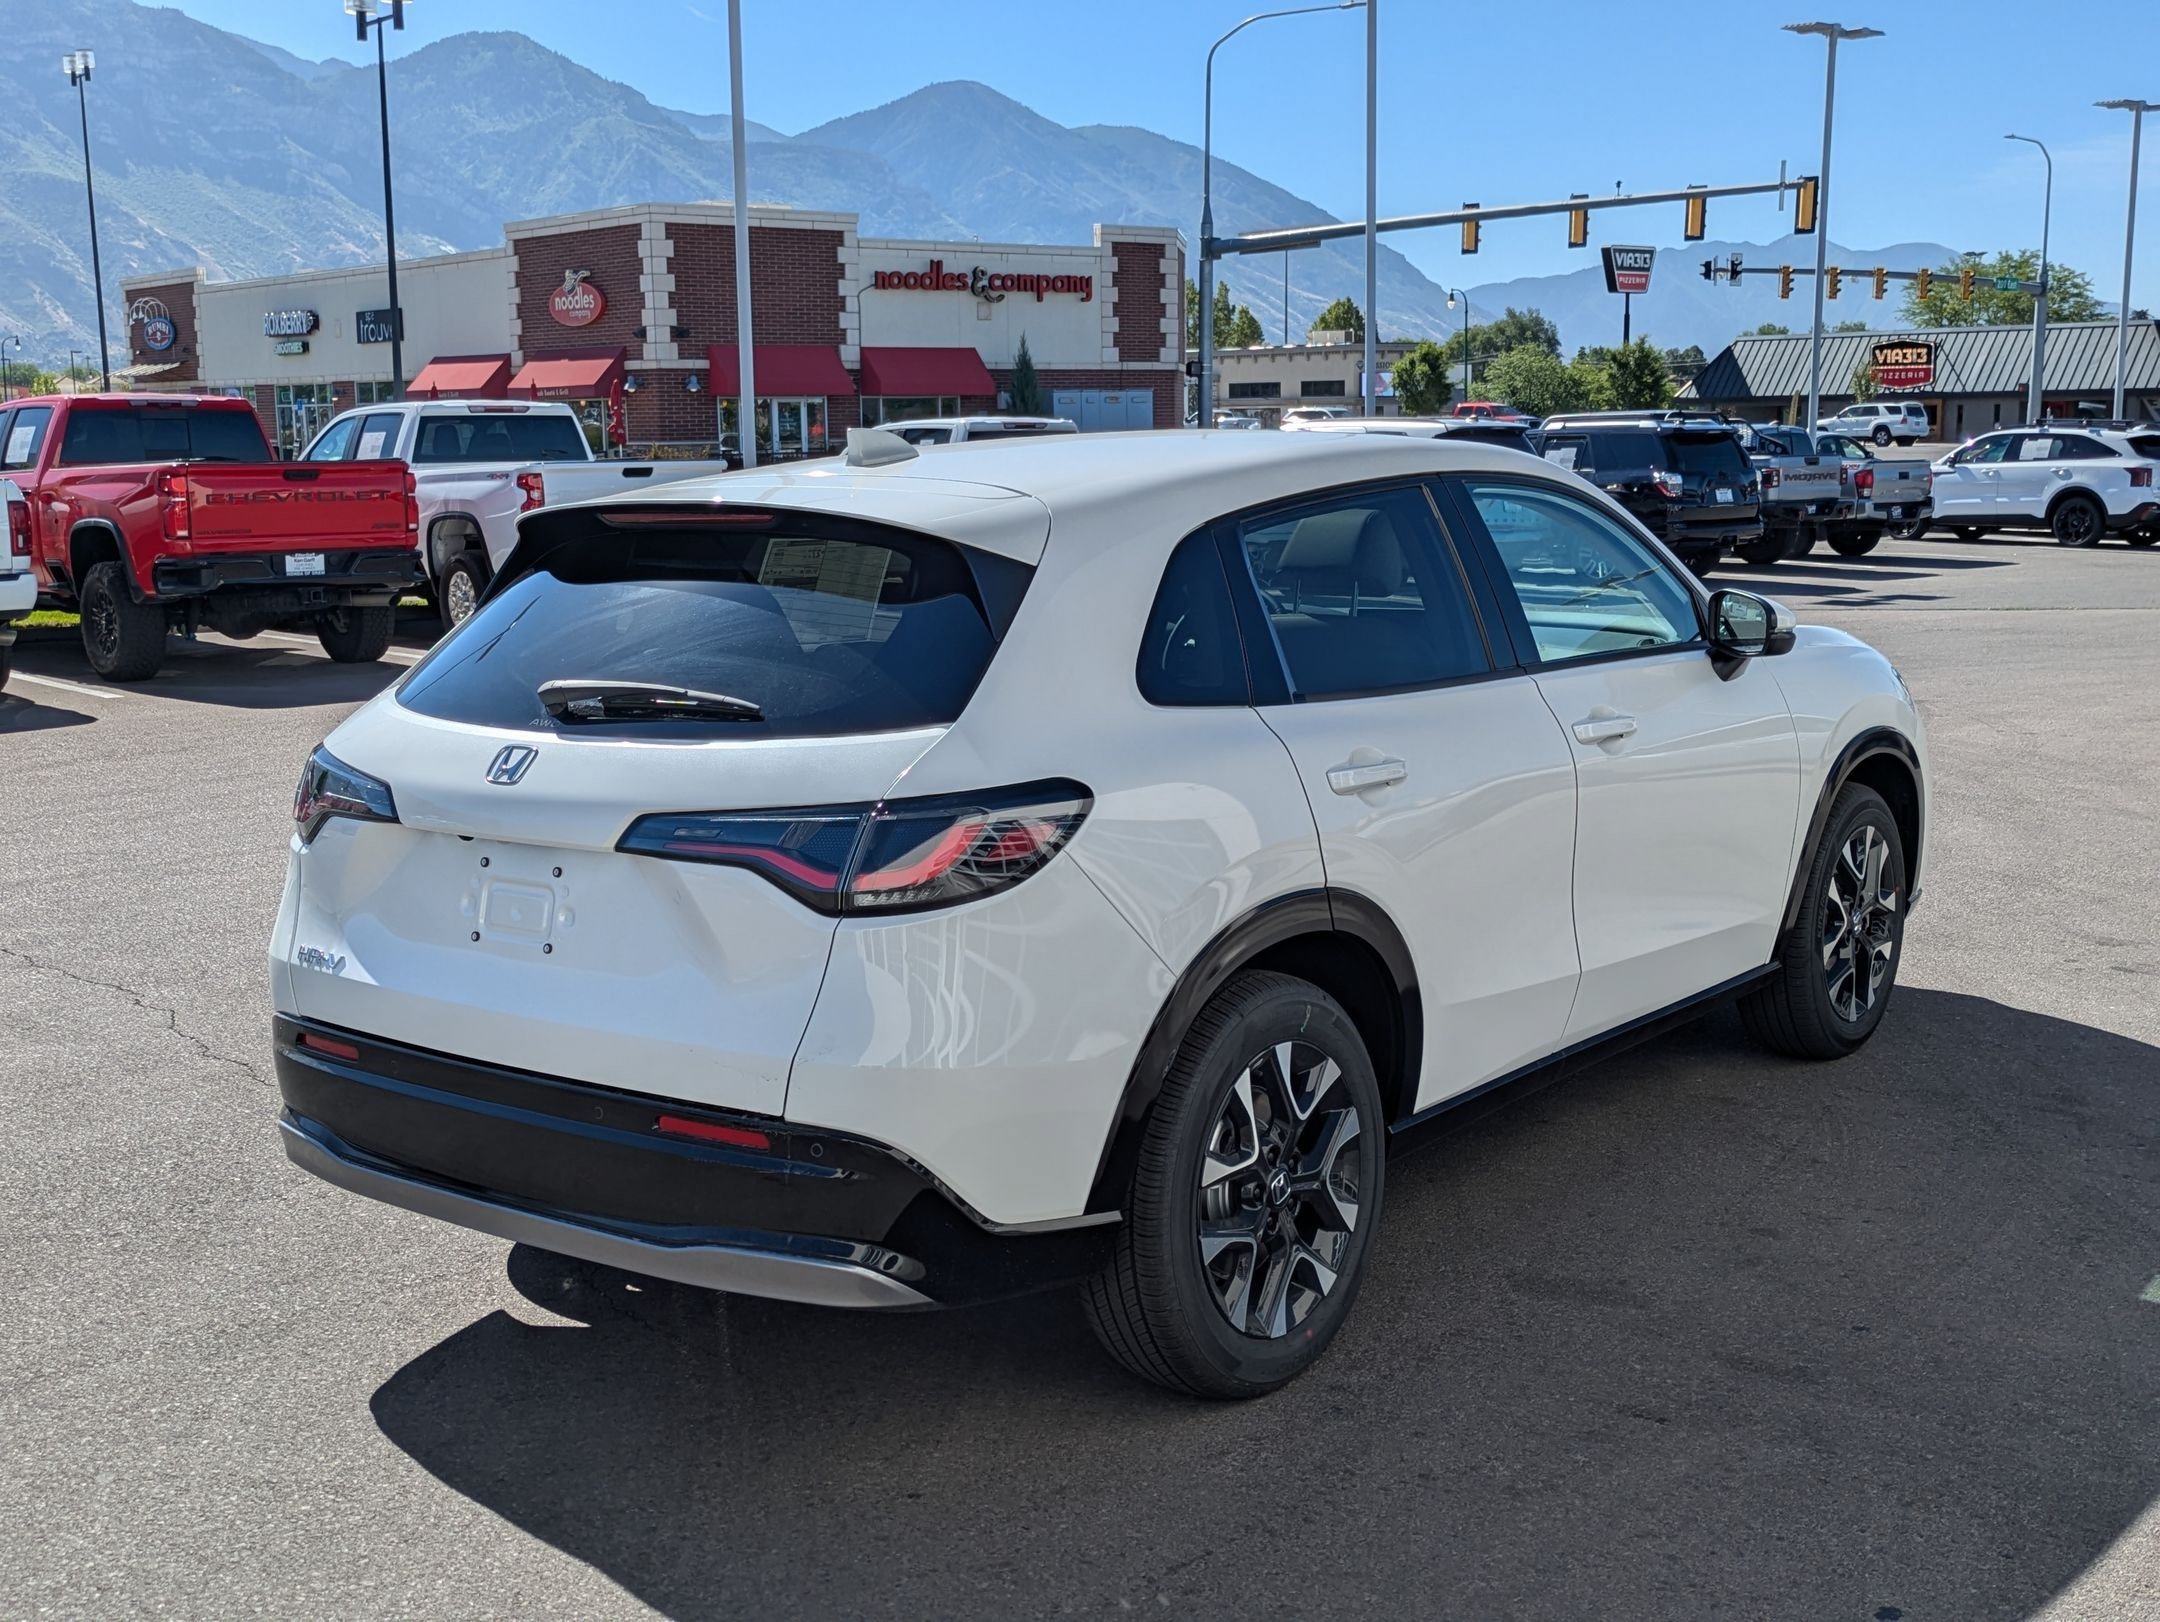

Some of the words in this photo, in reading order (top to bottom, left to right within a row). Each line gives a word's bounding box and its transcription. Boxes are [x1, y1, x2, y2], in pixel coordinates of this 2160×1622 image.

[875, 259, 969, 291] noodles
[970, 265, 1005, 303] &
[988, 272, 1093, 302] company
[555, 285, 595, 311] noodles
[264, 310, 307, 336] ROXBERRY
[569, 310, 591, 319] company
[360, 319, 393, 342] trouv
[1878, 371, 1925, 379] PIZZERIA
[1784, 472, 1837, 482] MOJAVE
[206, 489, 391, 505] CHEVROLET
